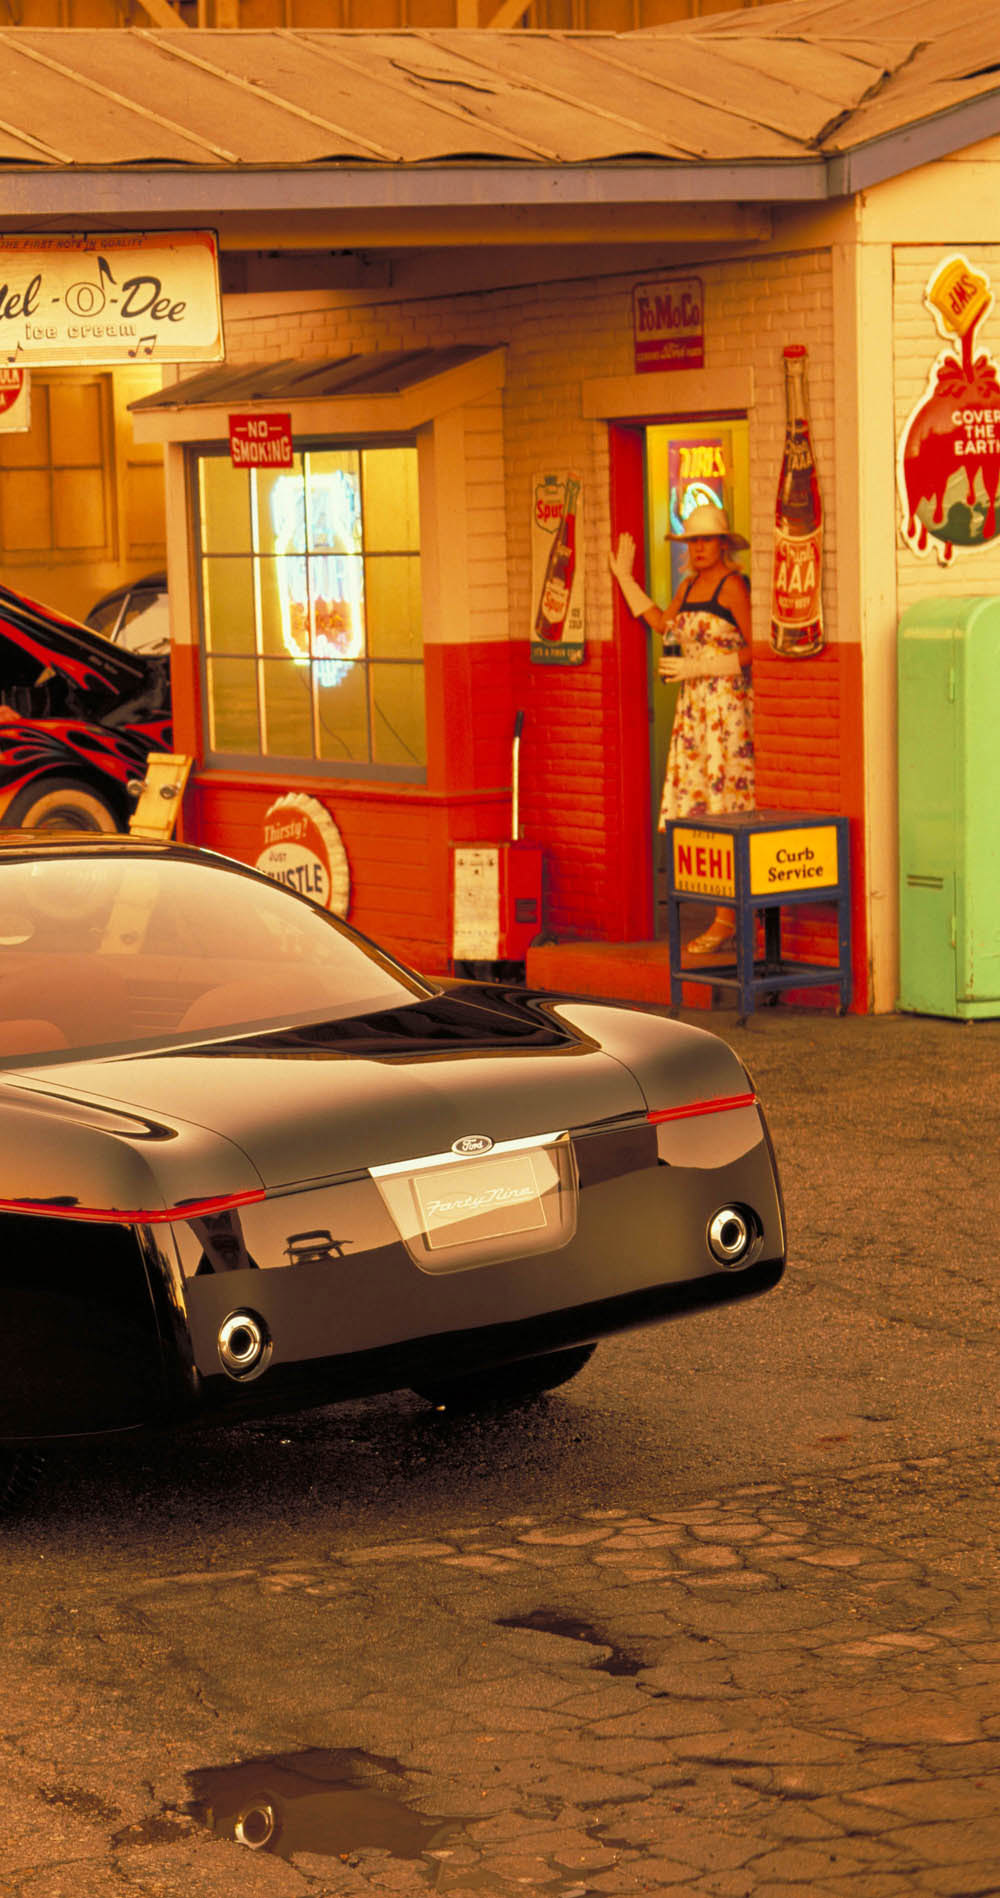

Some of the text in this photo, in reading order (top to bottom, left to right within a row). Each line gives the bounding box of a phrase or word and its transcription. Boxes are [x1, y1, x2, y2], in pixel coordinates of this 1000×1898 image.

[949, 274, 978, 315] SWP
[26, 323, 136, 340] ice cream
[951, 410, 1000, 425] COVER
[965, 425, 995, 439] THE
[232, 437, 291, 462] SMOKING
[536, 500, 563, 522] Spur
[777, 561, 815, 593] AAA
[678, 844, 732, 880] NEHI
[776, 847, 815, 863] Curb
[260, 863, 323, 894] ISTLE
[768, 865, 823, 882] Service
